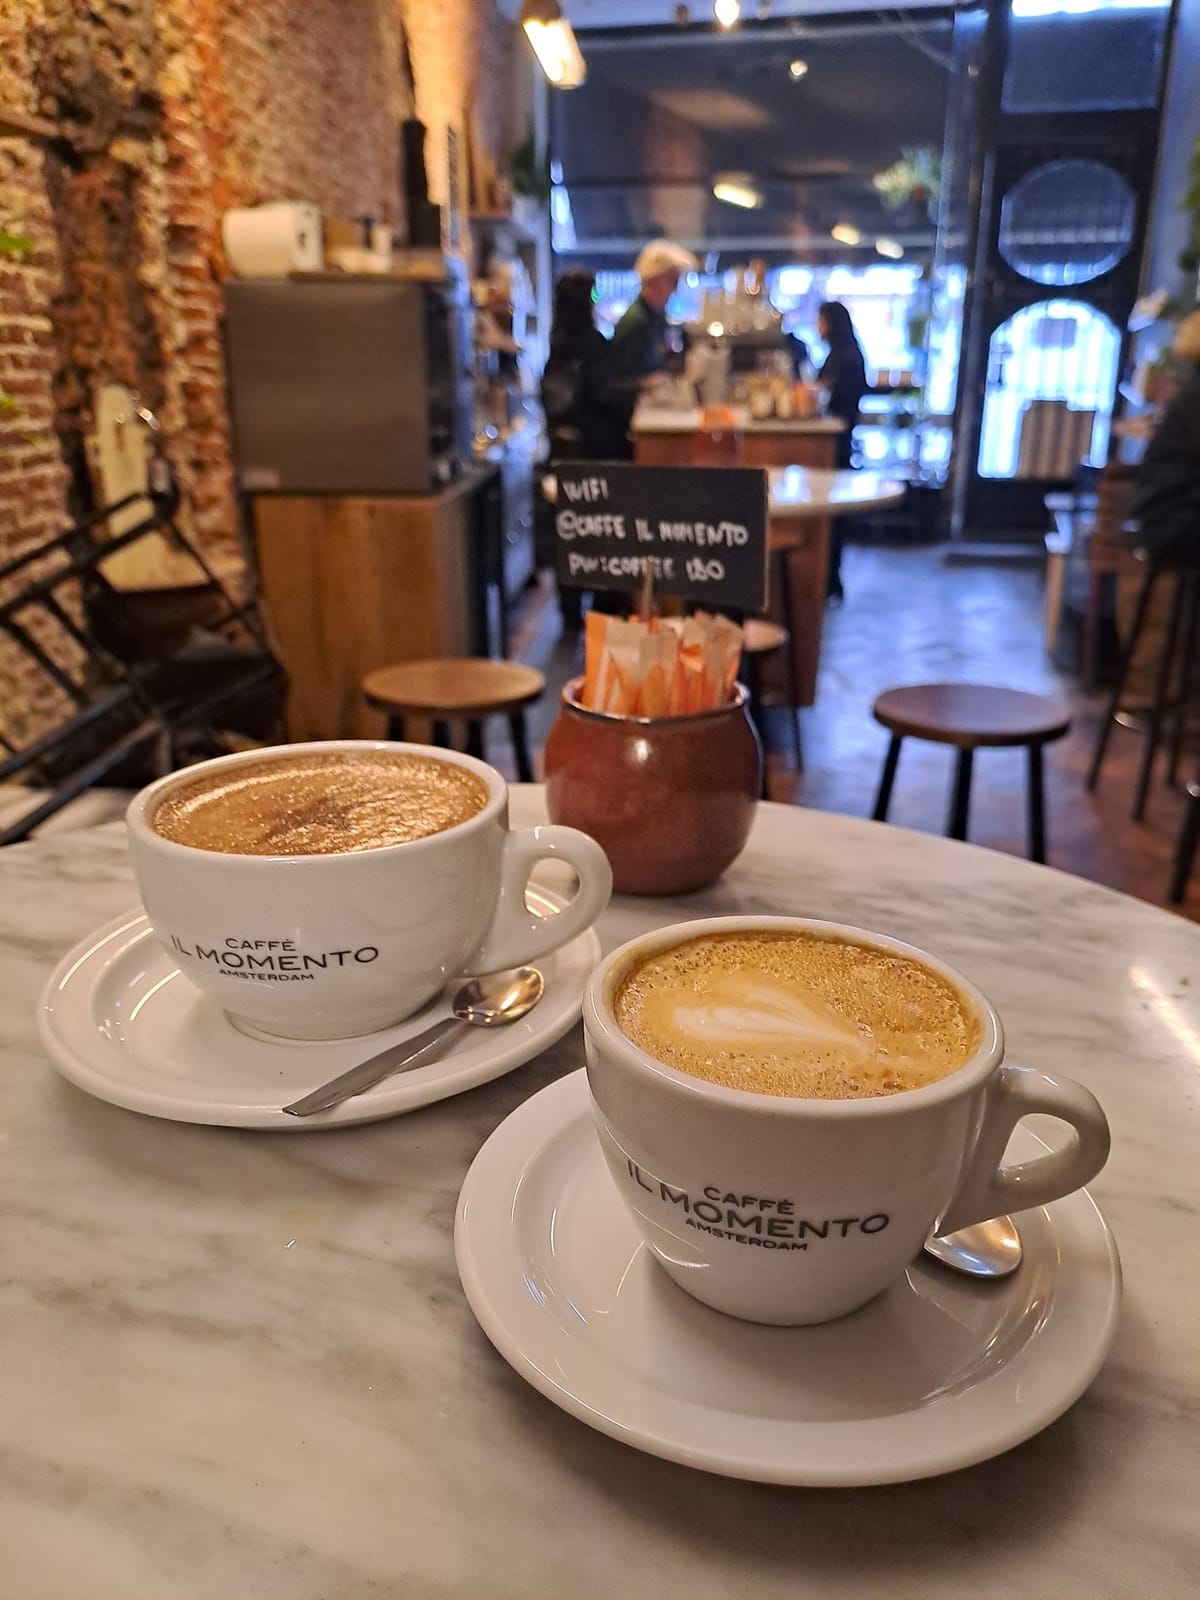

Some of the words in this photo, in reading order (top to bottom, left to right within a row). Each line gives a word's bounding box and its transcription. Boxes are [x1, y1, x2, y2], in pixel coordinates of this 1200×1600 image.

[635, 518, 654, 543] IL
[170, 934, 193, 956] IL
[195, 944, 379, 971] MOMENTO
[219, 968, 314, 981] AMSTERDAM
[627, 1159, 653, 1193] IL
[659, 1182, 890, 1239] MOMENTO
[685, 1218, 808, 1251] AMSTERDAM
